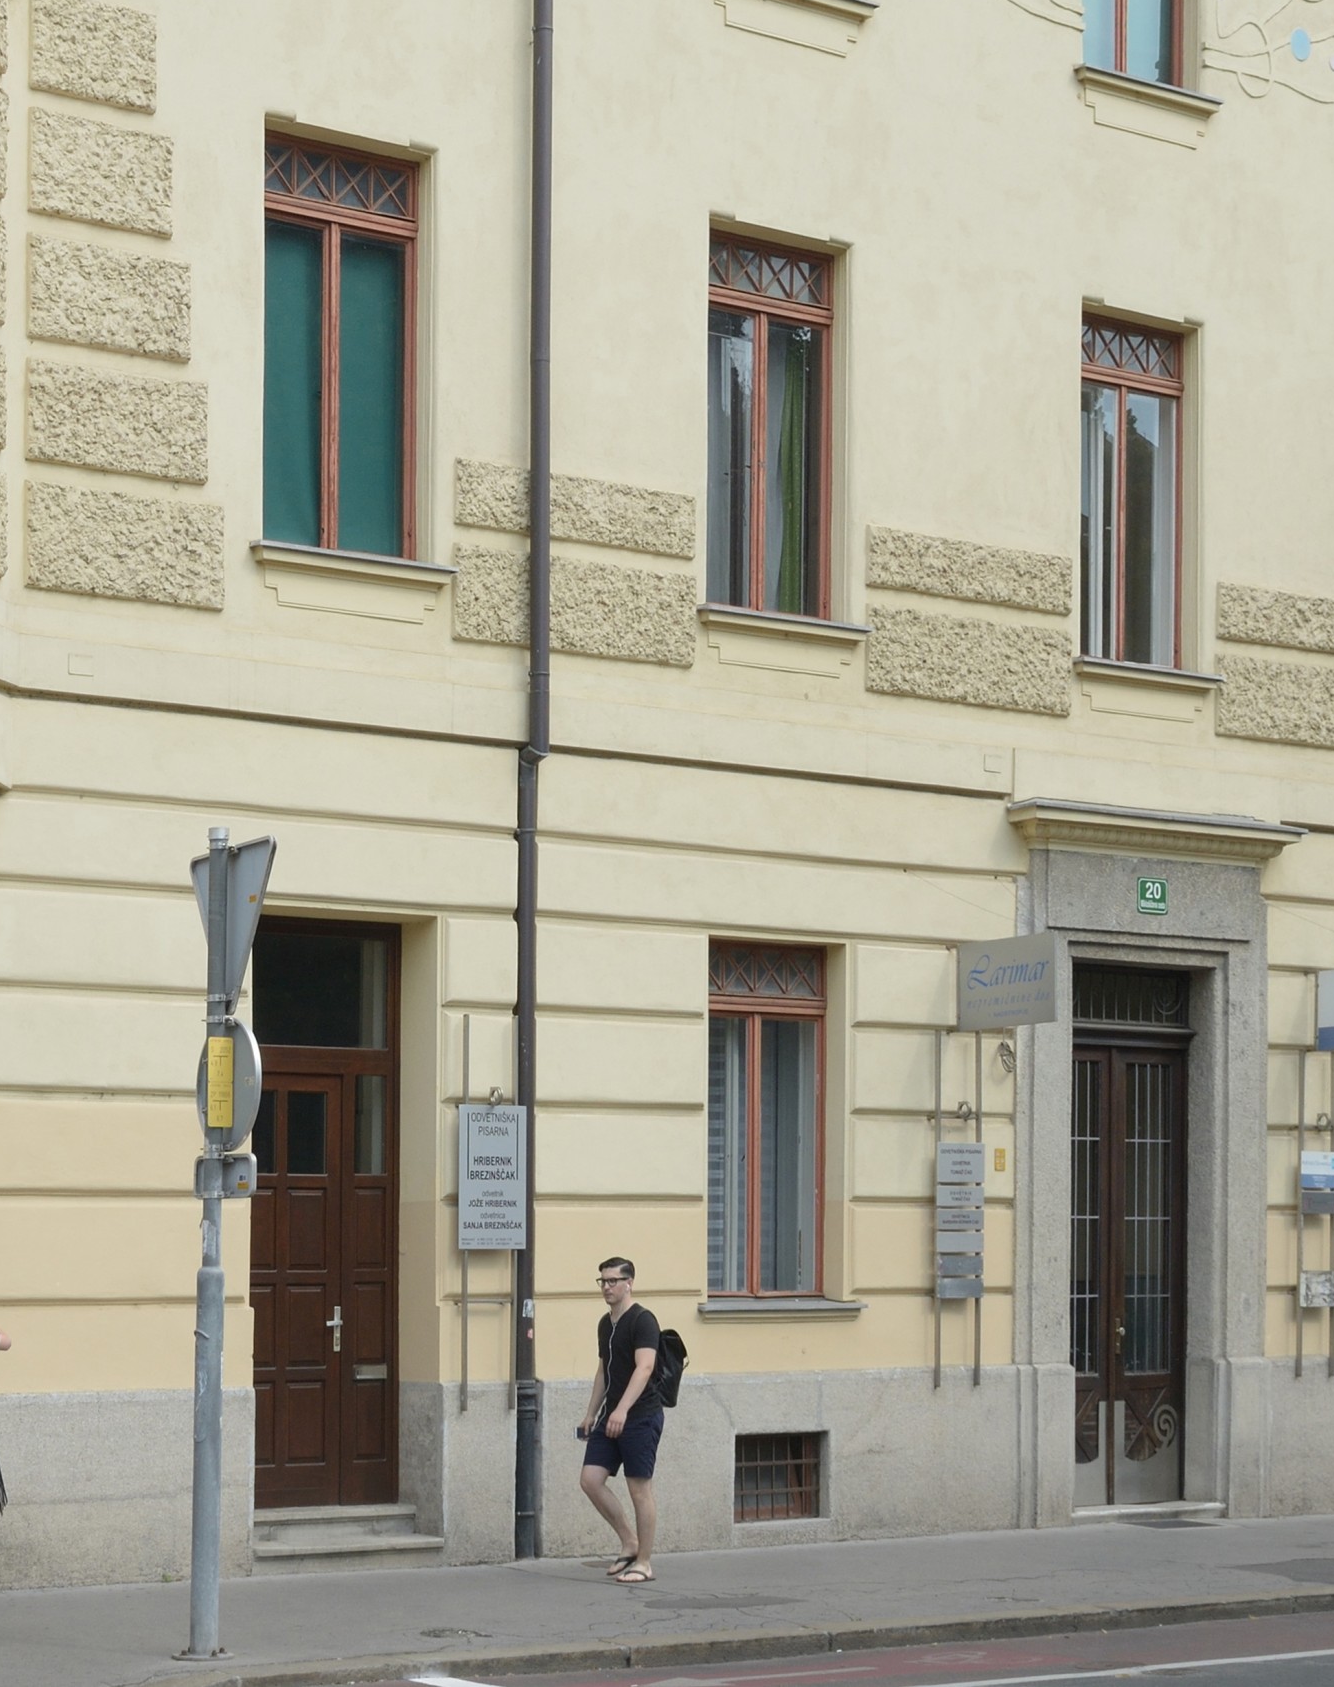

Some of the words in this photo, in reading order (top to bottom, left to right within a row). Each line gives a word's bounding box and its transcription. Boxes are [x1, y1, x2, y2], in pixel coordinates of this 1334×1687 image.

[1145, 882, 1162, 899] 20
[967, 954, 1049, 990] Larimar
[470, 1111, 516, 1123] ODVETNIŠKA
[478, 1126, 509, 1136] PISARNA
[473, 1156, 512, 1166] HRIBERNIK
[469, 1168, 516, 1181] BREZINŠČAK
[468, 1198, 484, 1208] JOŽE
[484, 1199, 517, 1208] HRIBERNIK
[480, 1212, 506, 1220] odvetnica
[463, 1221, 484, 1230] SANJA
[484, 1220, 523, 1230] BREZINŠČAK
